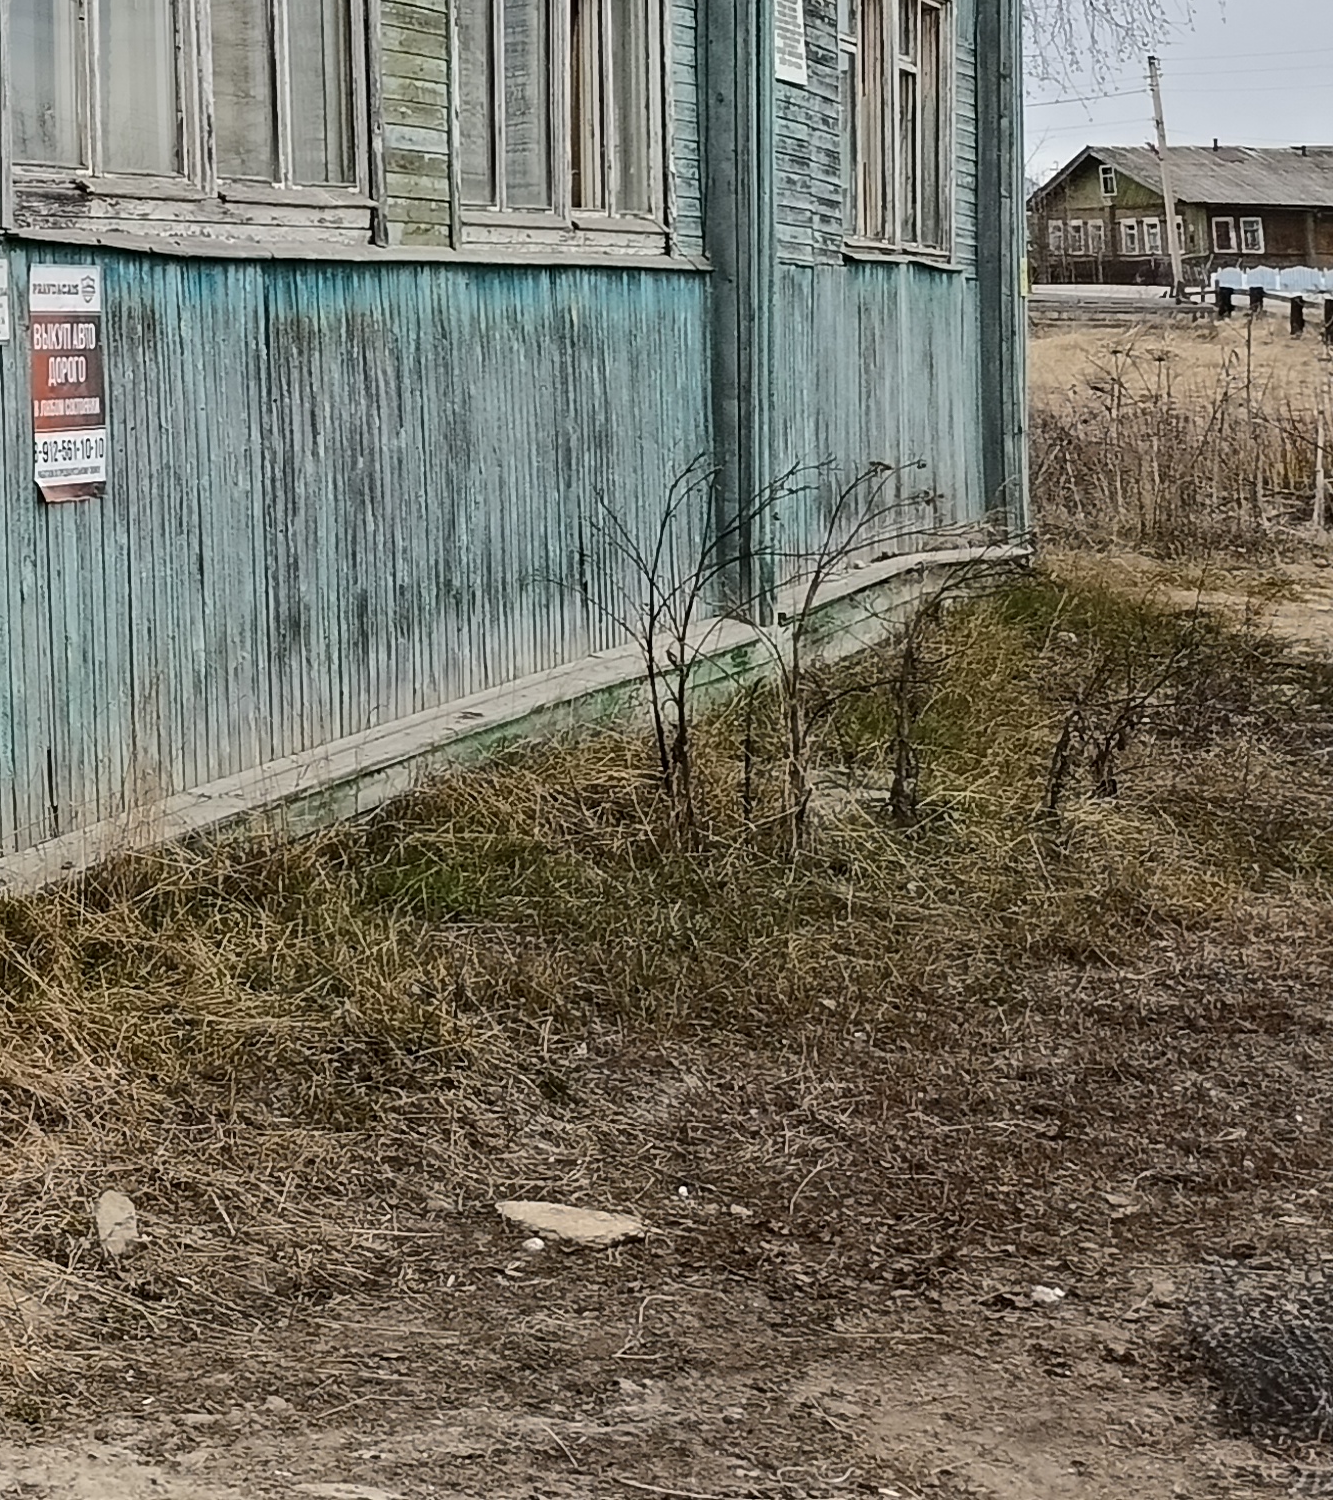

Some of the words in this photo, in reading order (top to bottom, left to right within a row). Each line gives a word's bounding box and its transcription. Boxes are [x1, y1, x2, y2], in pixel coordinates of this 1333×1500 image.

[33, 323, 72, 350] ВЫКУП
[72, 323, 96, 350] АВТО
[48, 355, 87, 387] ДОРОГО
